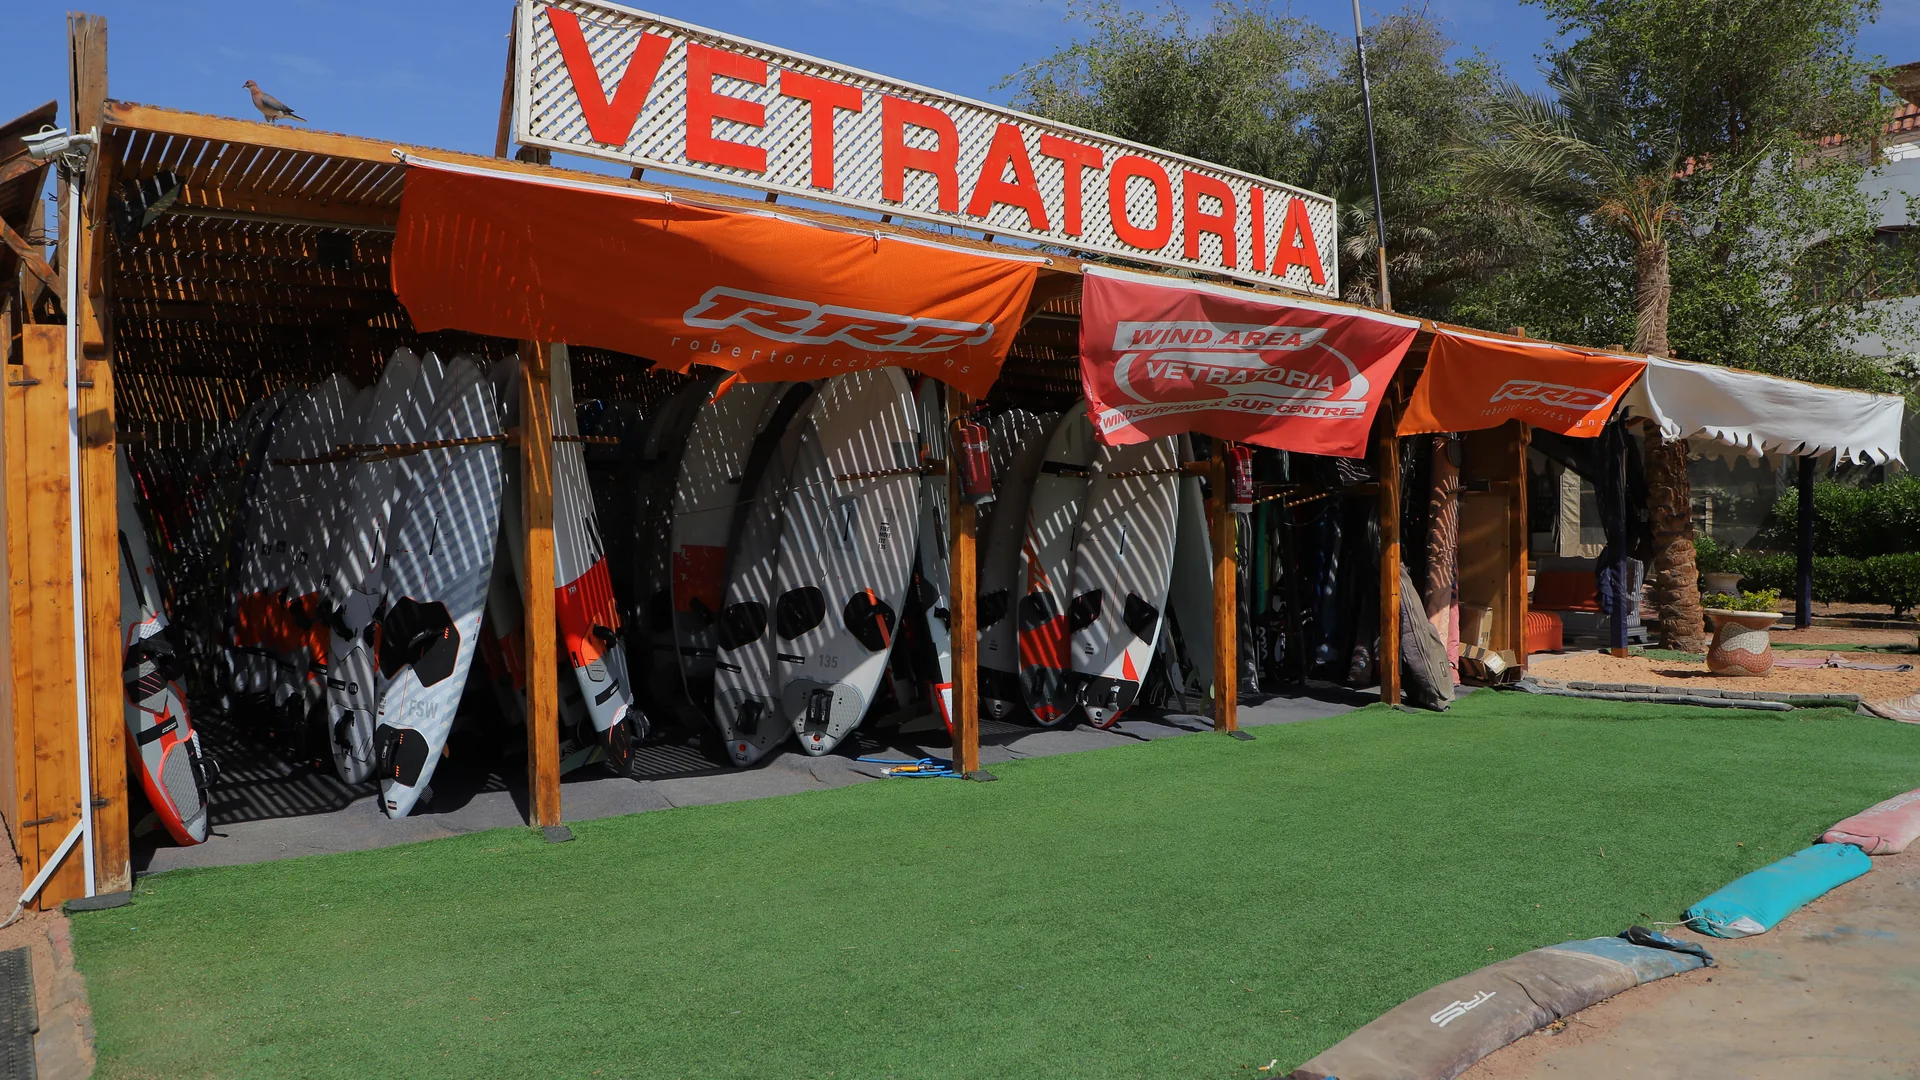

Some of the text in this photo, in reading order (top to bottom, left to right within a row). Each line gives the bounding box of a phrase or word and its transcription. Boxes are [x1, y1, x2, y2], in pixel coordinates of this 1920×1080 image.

[546, 7, 1326, 286] VETRATORIA
[683, 286, 993, 353] RRD
[1126, 328, 1305, 348] WIND AREA
[1145, 361, 1333, 391] VETRATORIA
[1489, 379, 1611, 411] RRD
[1102, 399, 1356, 429] WINDSURFING & SUP CENTRE
[818, 654, 838, 669] 135
[407, 698, 438, 719] FSW
